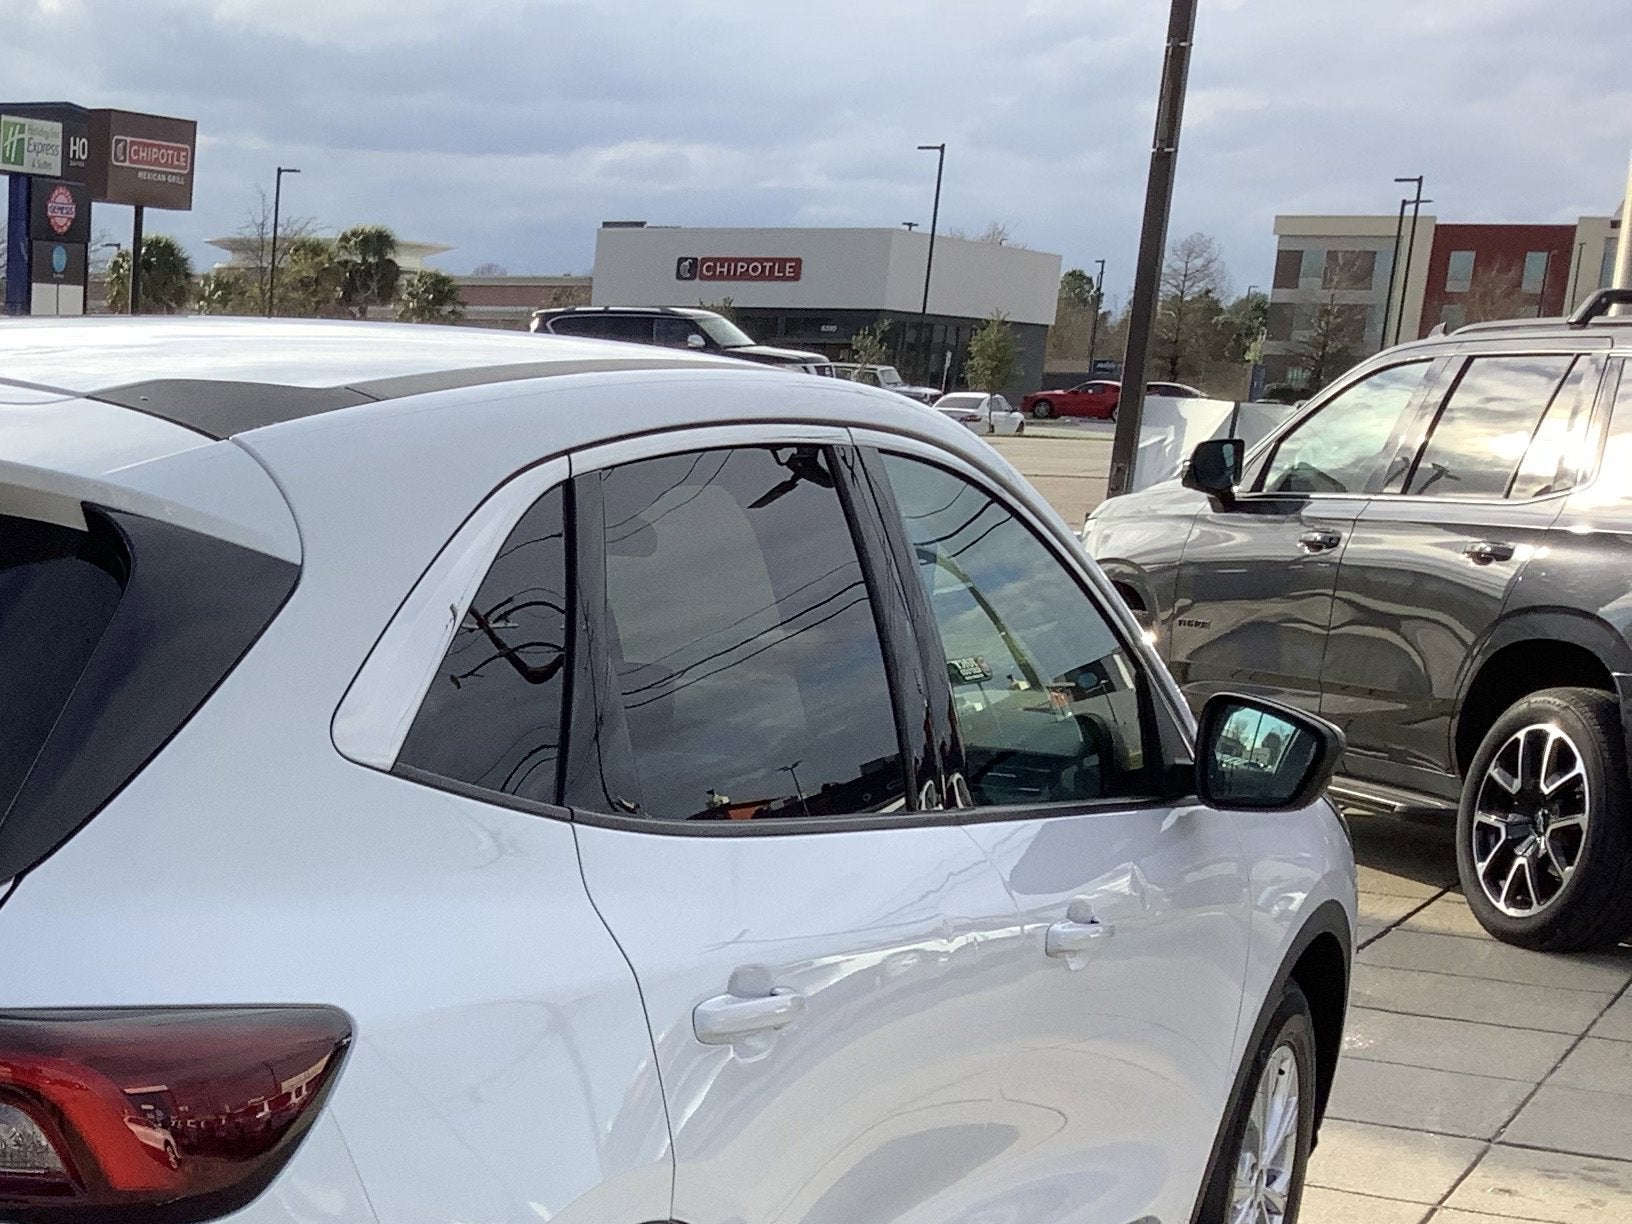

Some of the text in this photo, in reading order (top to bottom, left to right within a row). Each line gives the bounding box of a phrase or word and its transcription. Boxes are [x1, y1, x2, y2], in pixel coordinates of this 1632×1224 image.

[26, 136, 60, 157] Express
[130, 145, 187, 167] CHIPOTLE
[137, 171, 185, 185] MEXICAN GRILL
[702, 261, 796, 277] CHIPOTLE
